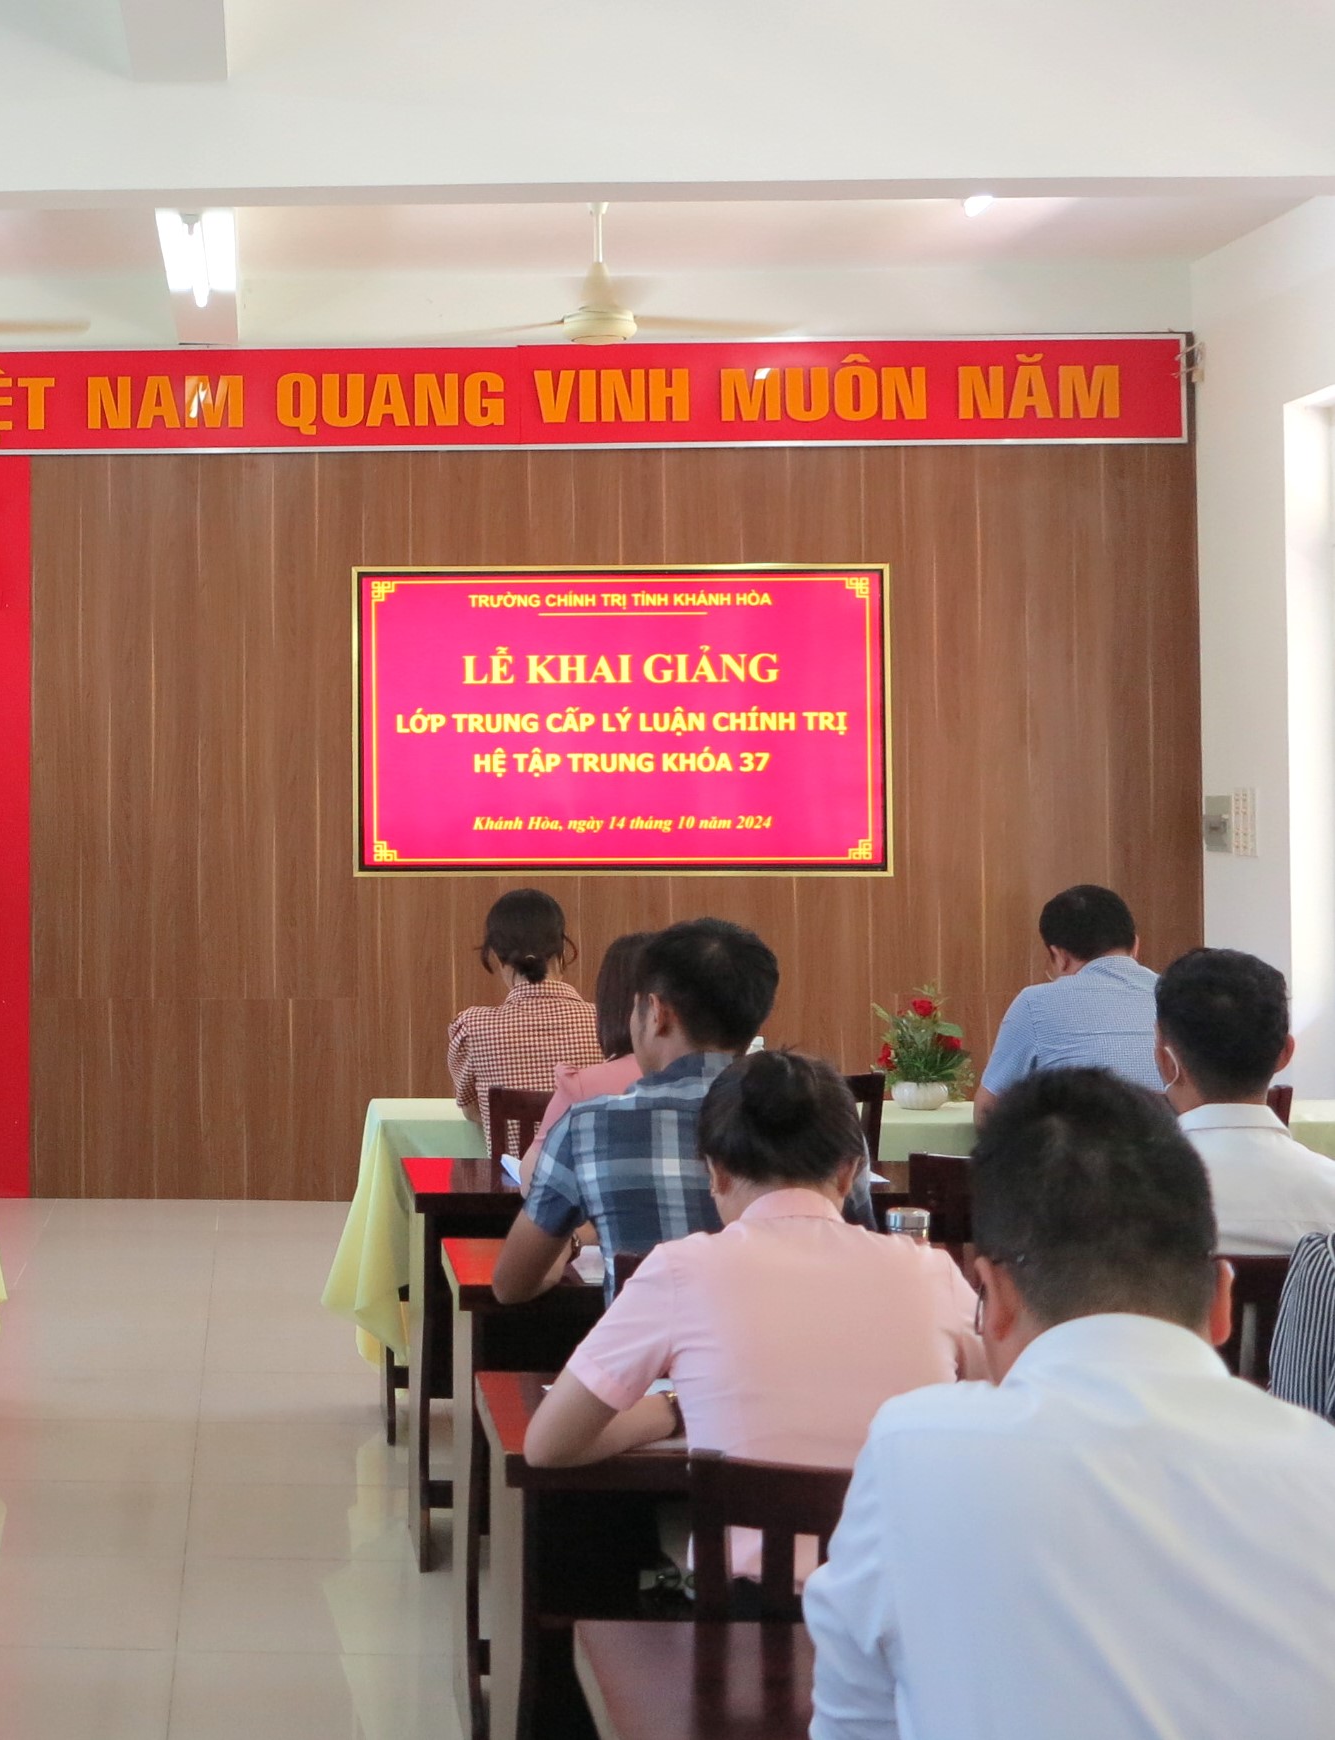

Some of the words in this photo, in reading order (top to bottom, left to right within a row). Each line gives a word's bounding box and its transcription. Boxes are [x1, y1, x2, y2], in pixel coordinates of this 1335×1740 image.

[87, 374, 243, 430] NAM
[276, 371, 506, 435] QUANG
[534, 367, 691, 423] VINH
[719, 353, 927, 421] MUÔN
[958, 350, 1120, 420] NĂM
[468, 591, 541, 608] TRƯỜNG
[545, 592, 596, 608] CHÍNH
[601, 593, 627, 610] TRỊ
[632, 590, 668, 607] TỈNH
[673, 589, 732, 607] KHÁNH
[735, 589, 772, 607] HÒA
[462, 646, 515, 685] LỄ
[526, 655, 632, 684] KHAI
[642, 645, 779, 684] GIẢNG
[396, 708, 446, 733] LỚP
[451, 713, 540, 733] TRUNG
[545, 707, 595, 733] CẤP
[602, 707, 632, 732] LÝ
[639, 707, 706, 735] LUẬN
[712, 706, 796, 732] CHÍNH
[802, 711, 848, 735] TRỊ
[473, 747, 507, 778] HỆ
[513, 747, 562, 778] TẬP
[566, 752, 654, 773] TRUNG
[661, 747, 734, 773] KHÓA
[739, 752, 770, 772] 37
[472, 816, 523, 831] Khánh
[527, 816, 564, 832] Hòa,
[567, 816, 605, 834] ngày
[609, 815, 627, 830] 14
[630, 815, 673, 833] tháng
[678, 815, 695, 830] 10
[699, 815, 733, 830] năm
[736, 815, 772, 830] 2024
